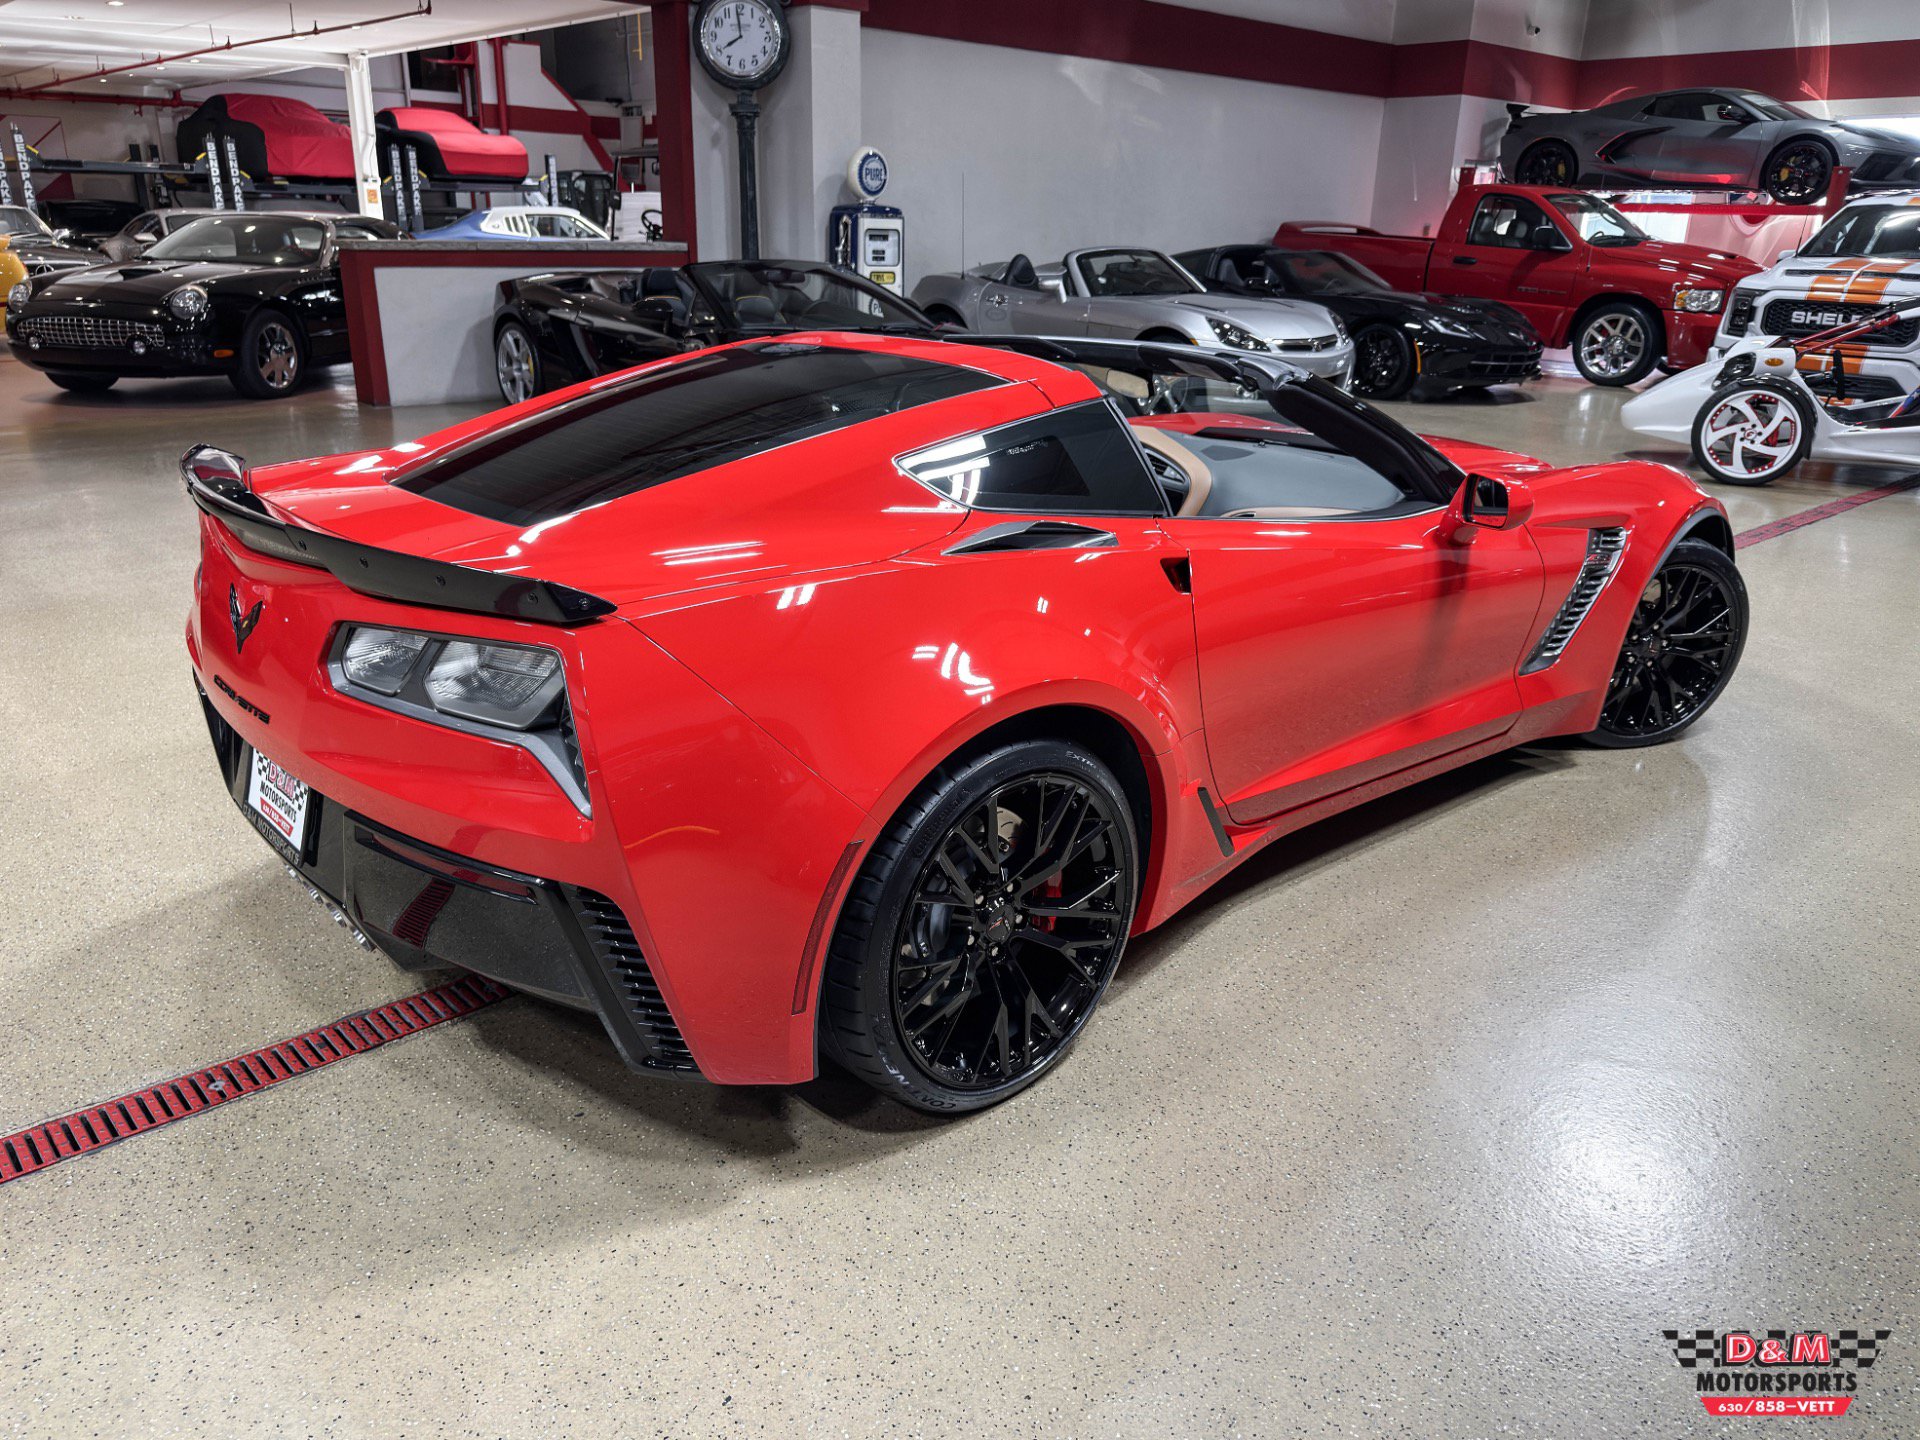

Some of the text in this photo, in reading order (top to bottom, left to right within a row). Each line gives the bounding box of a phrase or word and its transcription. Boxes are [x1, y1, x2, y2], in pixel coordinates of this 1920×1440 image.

[723, 7, 731, 19] 11
[714, 17, 724, 28] 10
[759, 16, 766, 28] 2
[710, 31, 717, 42] 9
[764, 31, 772, 43] 3
[715, 45, 723, 56] 8
[726, 55, 732, 66] 7
[739, 58, 746, 70] 6
[751, 55, 758, 66] 5
[1790, 310, 1864, 326] SHEL
[213, 674, 271, 725] CORVETTE
[268, 760, 297, 801] D&M
[260, 780, 298, 824] MOTORSPORTS
[257, 819, 300, 866] MOTORSPORTS
